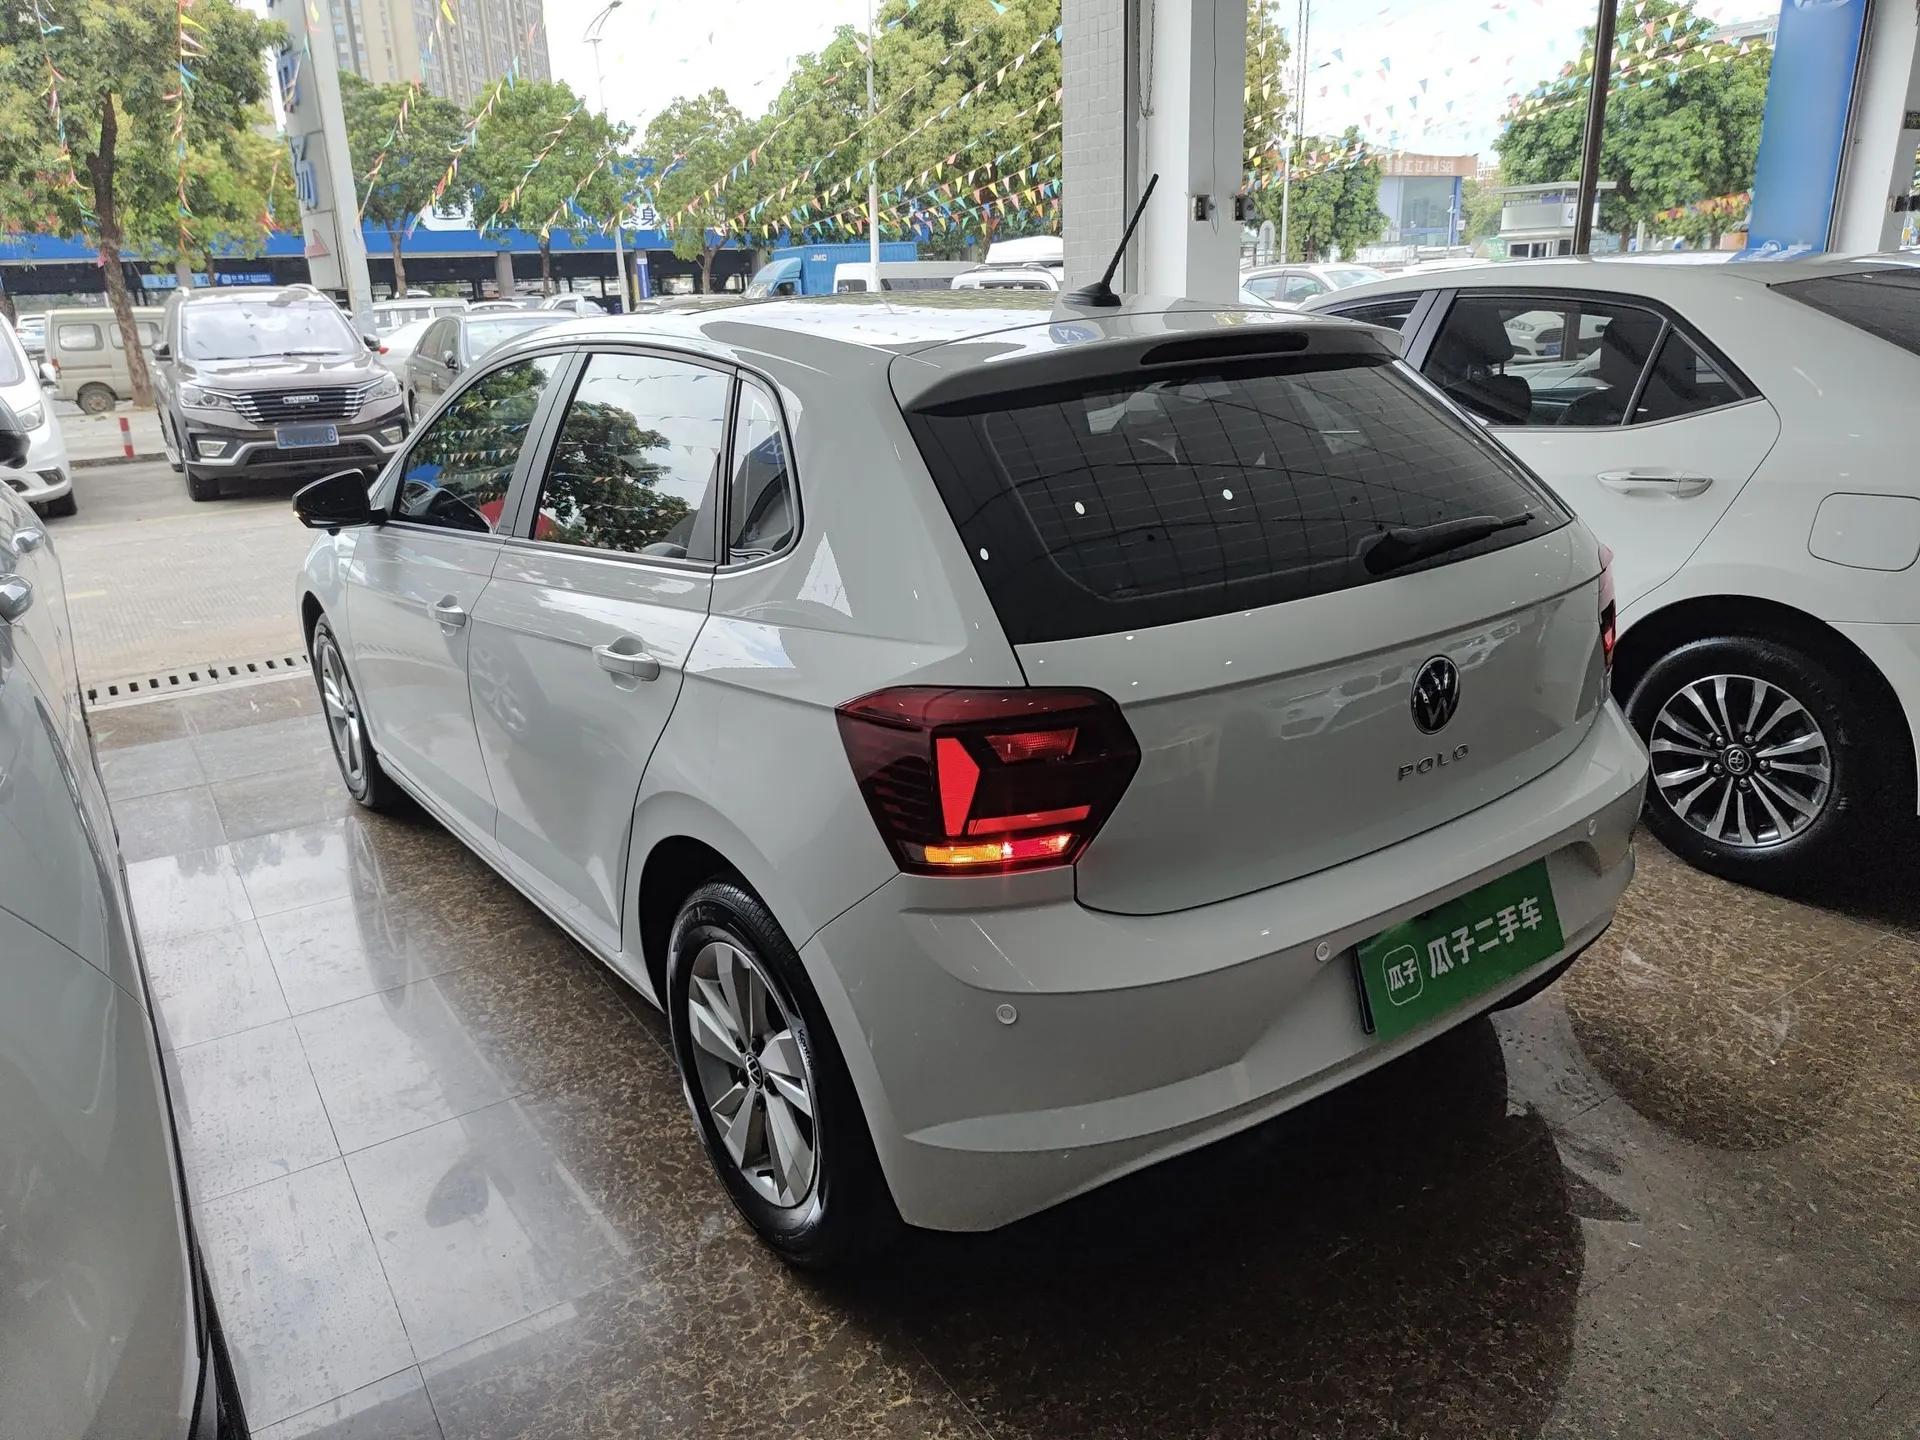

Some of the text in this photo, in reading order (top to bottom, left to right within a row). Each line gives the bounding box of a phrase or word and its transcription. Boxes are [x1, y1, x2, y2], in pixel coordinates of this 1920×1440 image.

[1398, 743, 1469, 781] POLO
[1427, 897, 1543, 978] 瓜子二手车
[1388, 958, 1417, 991] 瓜子
